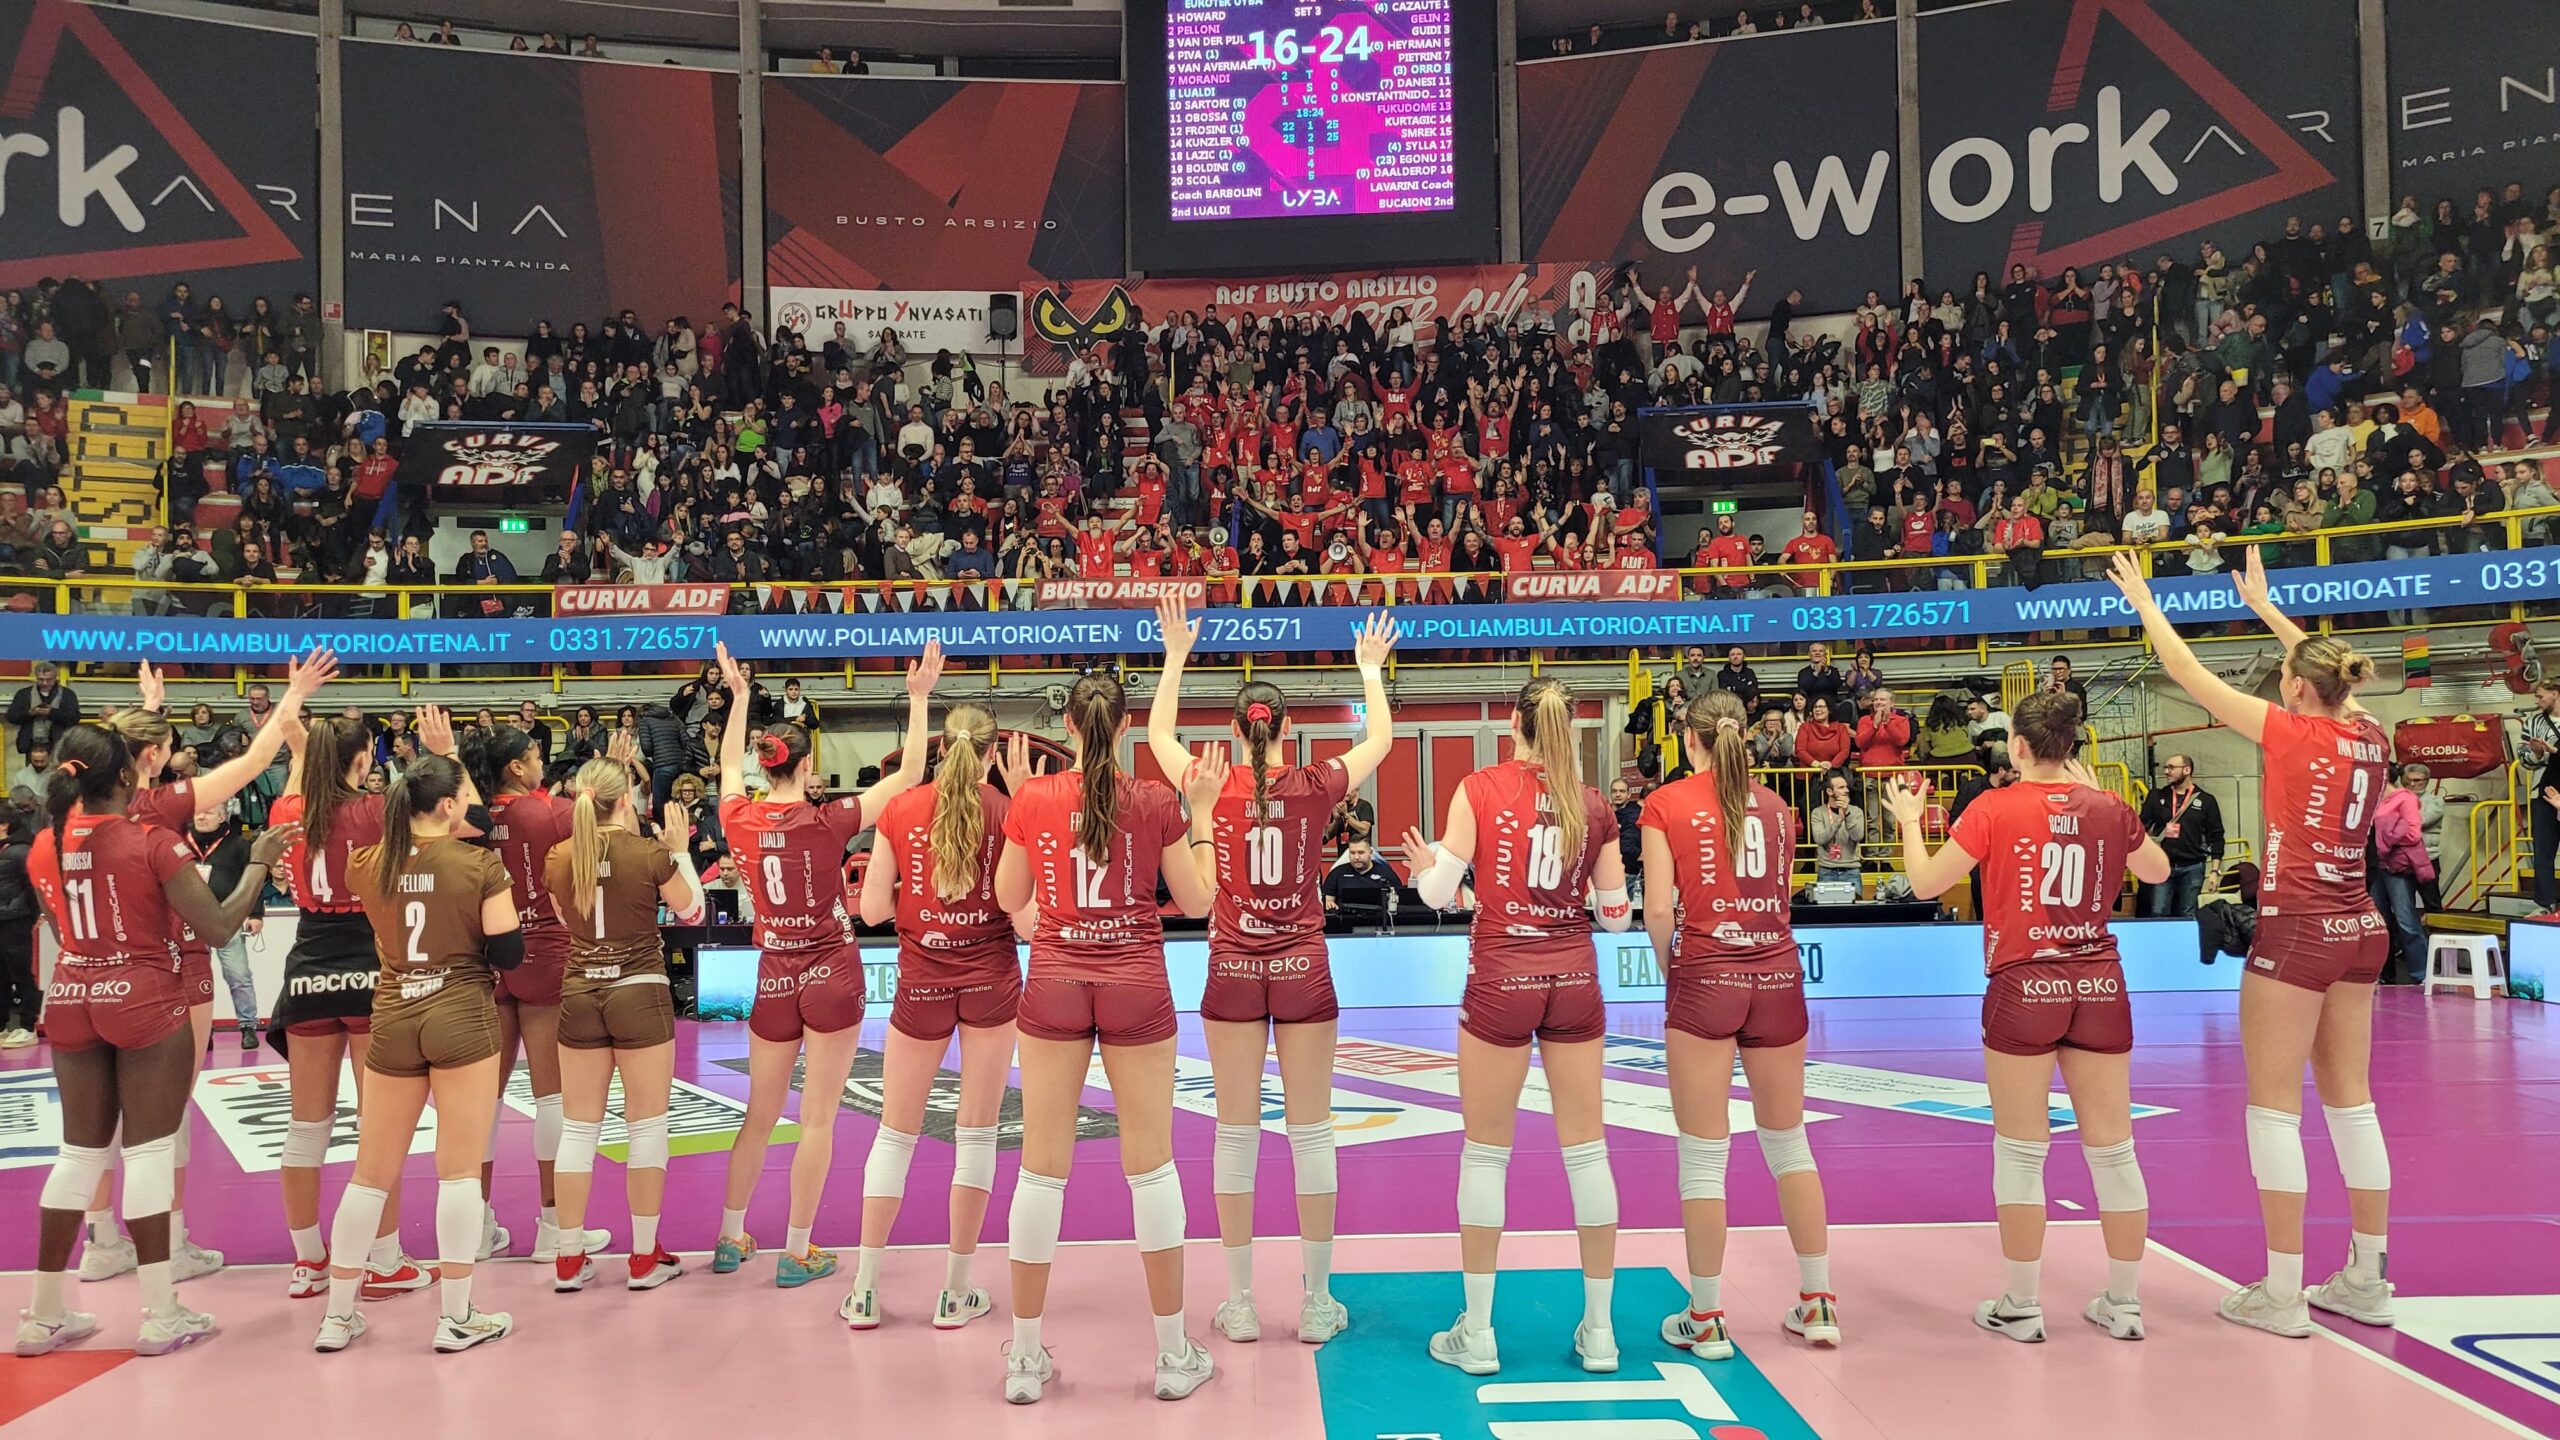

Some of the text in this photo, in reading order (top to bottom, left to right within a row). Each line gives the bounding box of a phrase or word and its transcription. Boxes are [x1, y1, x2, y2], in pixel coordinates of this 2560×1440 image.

[1294, 6, 1321, 17] SET 3
[1392, 1, 1441, 11] CAZAUTE
[1177, 11, 1226, 22] HOWARD
[1411, 14, 1440, 23] GELIN
[1177, 24, 1220, 35] PELLONI
[1412, 26, 1441, 36] GUIDI
[1177, 37, 1200, 47] VAN
[1203, 36, 1223, 46] DER
[1249, 26, 1371, 66] 16-24
[1388, 38, 1441, 50] HEYRMAN
[1178, 49, 1219, 60] PIVA (1)
[1398, 51, 1442, 62] PIETRINI
[1178, 63, 1200, 73] VAN
[1411, 64, 1442, 74] ORRO
[1178, 74, 1230, 85] MORANDI
[1380, 77, 1437, 90] (7) DANESI
[1178, 87, 1216, 98] LUALDI
[1170, 101, 1181, 110] 10
[1185, 99, 1230, 109] SARTORI
[1303, 95, 1317, 104] VC
[1296, 107, 1324, 118] 18:24
[1377, 102, 1452, 114] FUKUDOME 13
[1170, 112, 1228, 124] 11 OBOSSA
[1326, 120, 1339, 129] 25
[1385, 115, 1452, 127] KURTAGIC 14
[1170, 125, 1227, 136] 12 FROSINI
[1282, 122, 1295, 131] 22
[1401, 127, 1452, 138] SMREK 15
[1170, 139, 1182, 148] 14
[1185, 137, 1233, 148] KUNZLER
[1282, 134, 1295, 144] 23
[1326, 132, 1339, 141] 25
[1405, 140, 1437, 151] SYLLA
[1440, 140, 1452, 149] 17
[1171, 150, 1216, 161] 18 LAZIC
[1376, 153, 1453, 166] (23) EGONU 18
[2402, 146, 2486, 168] MARIA
[1186, 163, 1229, 173] BOLDINI
[1374, 166, 1437, 177] DAALDEROP
[1641, 85, 2178, 253] e-work
[1171, 175, 1221, 186] 20 SCOLA
[1370, 180, 1453, 192] LAVARINI Coach
[1171, 188, 1262, 200] Coach BARBOLINI
[1379, 196, 1453, 208] BUCAIONI 2nd
[1172, 206, 1231, 217] 2nd LUALDI
[837, 215, 1058, 231] BUSTO ARSIZIO
[2373, 222, 2385, 238] 7
[351, 250, 571, 272] MARIA PIANTANIDA
[1266, 281, 1339, 304] BUSTO
[1347, 275, 1437, 300] ARSIZIO
[816, 299, 887, 321] GRUPPO
[868, 329, 926, 340] SARATE
[1672, 415, 1785, 437] CURVA
[443, 433, 562, 452] CURVA
[1041, 582, 1202, 601] BUSTO ARSIZIO
[1512, 575, 1675, 598] CURVA ADF
[560, 588, 726, 611] CURVA ADF
[1792, 600, 1970, 631] 0331.726571
[550, 626, 719, 653] 0331.726571
[2421, 744, 2468, 757] GLOBUS
[2345, 768, 2369, 830] 3
[2048, 814, 2079, 835] SCOLA
[758, 832, 785, 849] LUALDI
[1735, 815, 1766, 879] 19
[1244, 826, 1284, 886] 10
[1526, 824, 1564, 891] 18
[1699, 838, 1717, 885] XIUI
[1496, 839, 1513, 888] XIUI
[311, 848, 333, 902] 4
[763, 855, 787, 905] 8
[911, 853, 924, 897] XIUI
[1069, 844, 1112, 909] 12
[2039, 842, 2086, 908] 20
[2019, 866, 2034, 913] XIUI
[1232, 893, 1302, 911] e-work
[1712, 894, 1782, 914] e-work
[65, 878, 98, 940] 11
[1505, 900, 1576, 919] e-work
[919, 908, 989, 925] e-work
[405, 901, 429, 962] 2
[2028, 921, 2099, 940] e-work
[290, 970, 381, 997] macron
